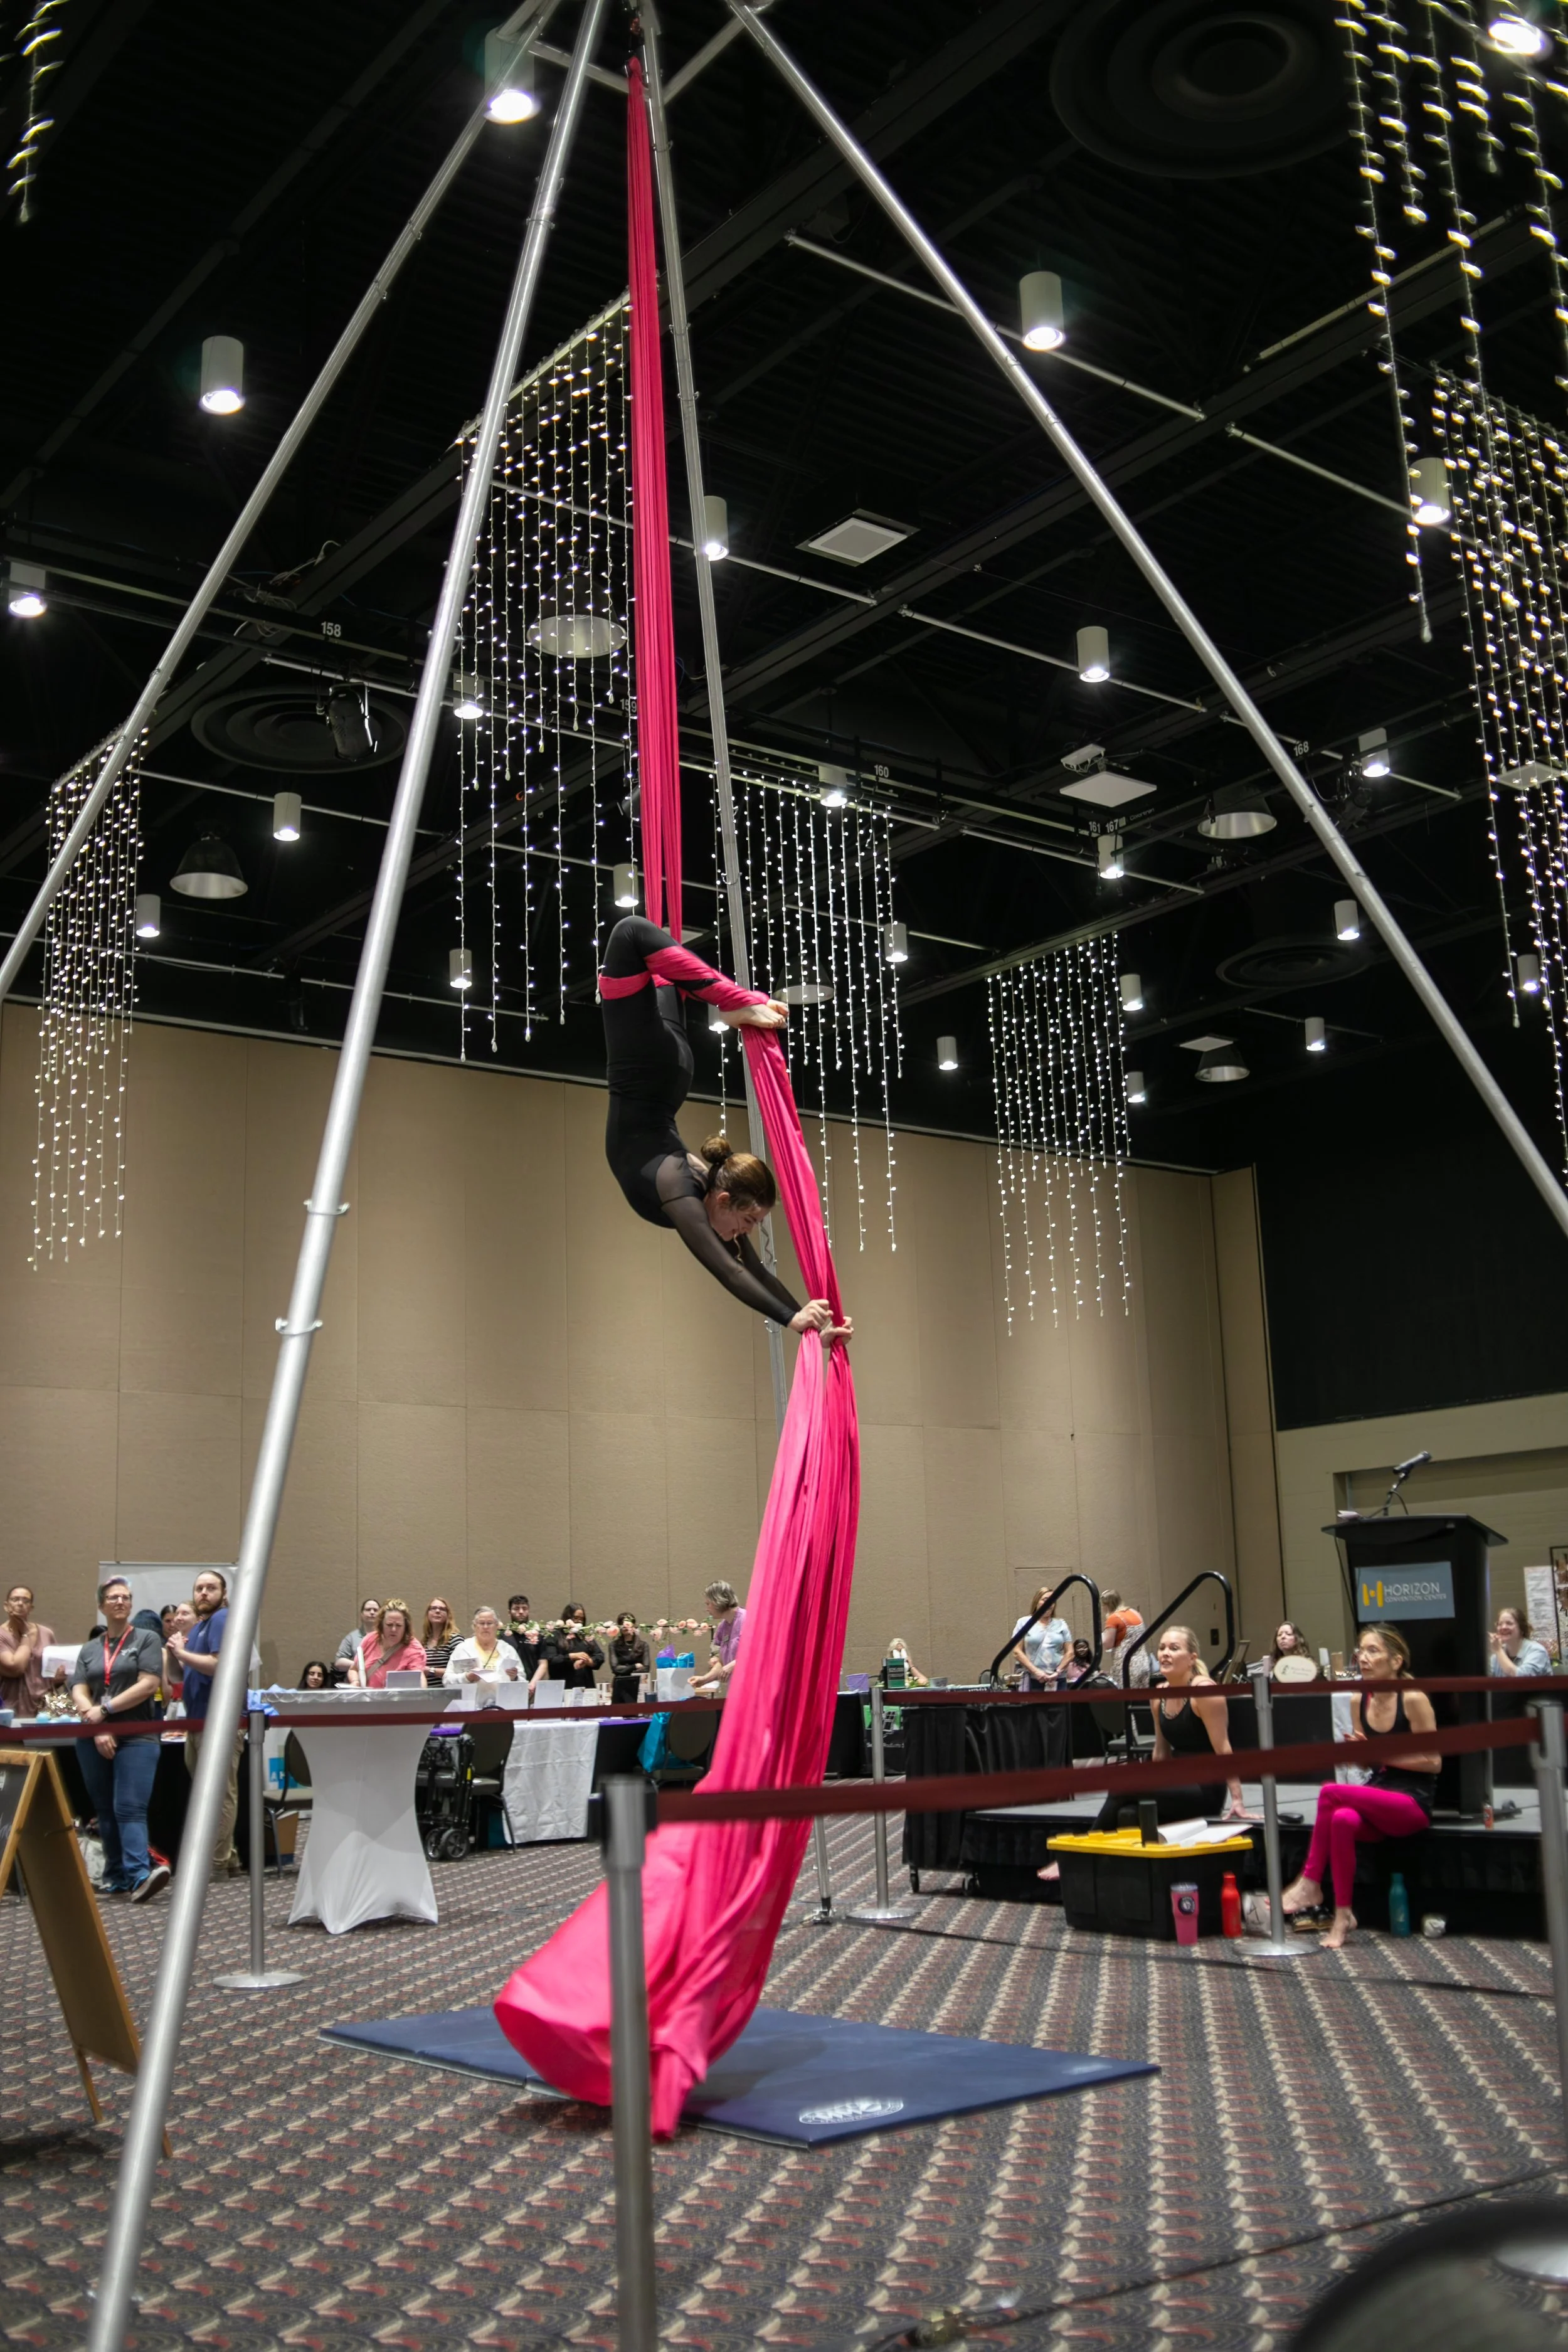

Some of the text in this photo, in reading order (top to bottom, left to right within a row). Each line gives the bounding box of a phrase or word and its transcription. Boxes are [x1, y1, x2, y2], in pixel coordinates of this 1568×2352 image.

[321, 621, 341, 637] 158
[620, 698, 637, 713] 159
[1294, 741, 1309, 756] 168
[874, 765, 889, 778] 160
[1089, 821, 1101, 834] 161
[1105, 818, 1118, 833] 167
[1384, 1582, 1439, 1596] HORIZON
[1385, 1593, 1446, 1603] CONVENTION CENTER
